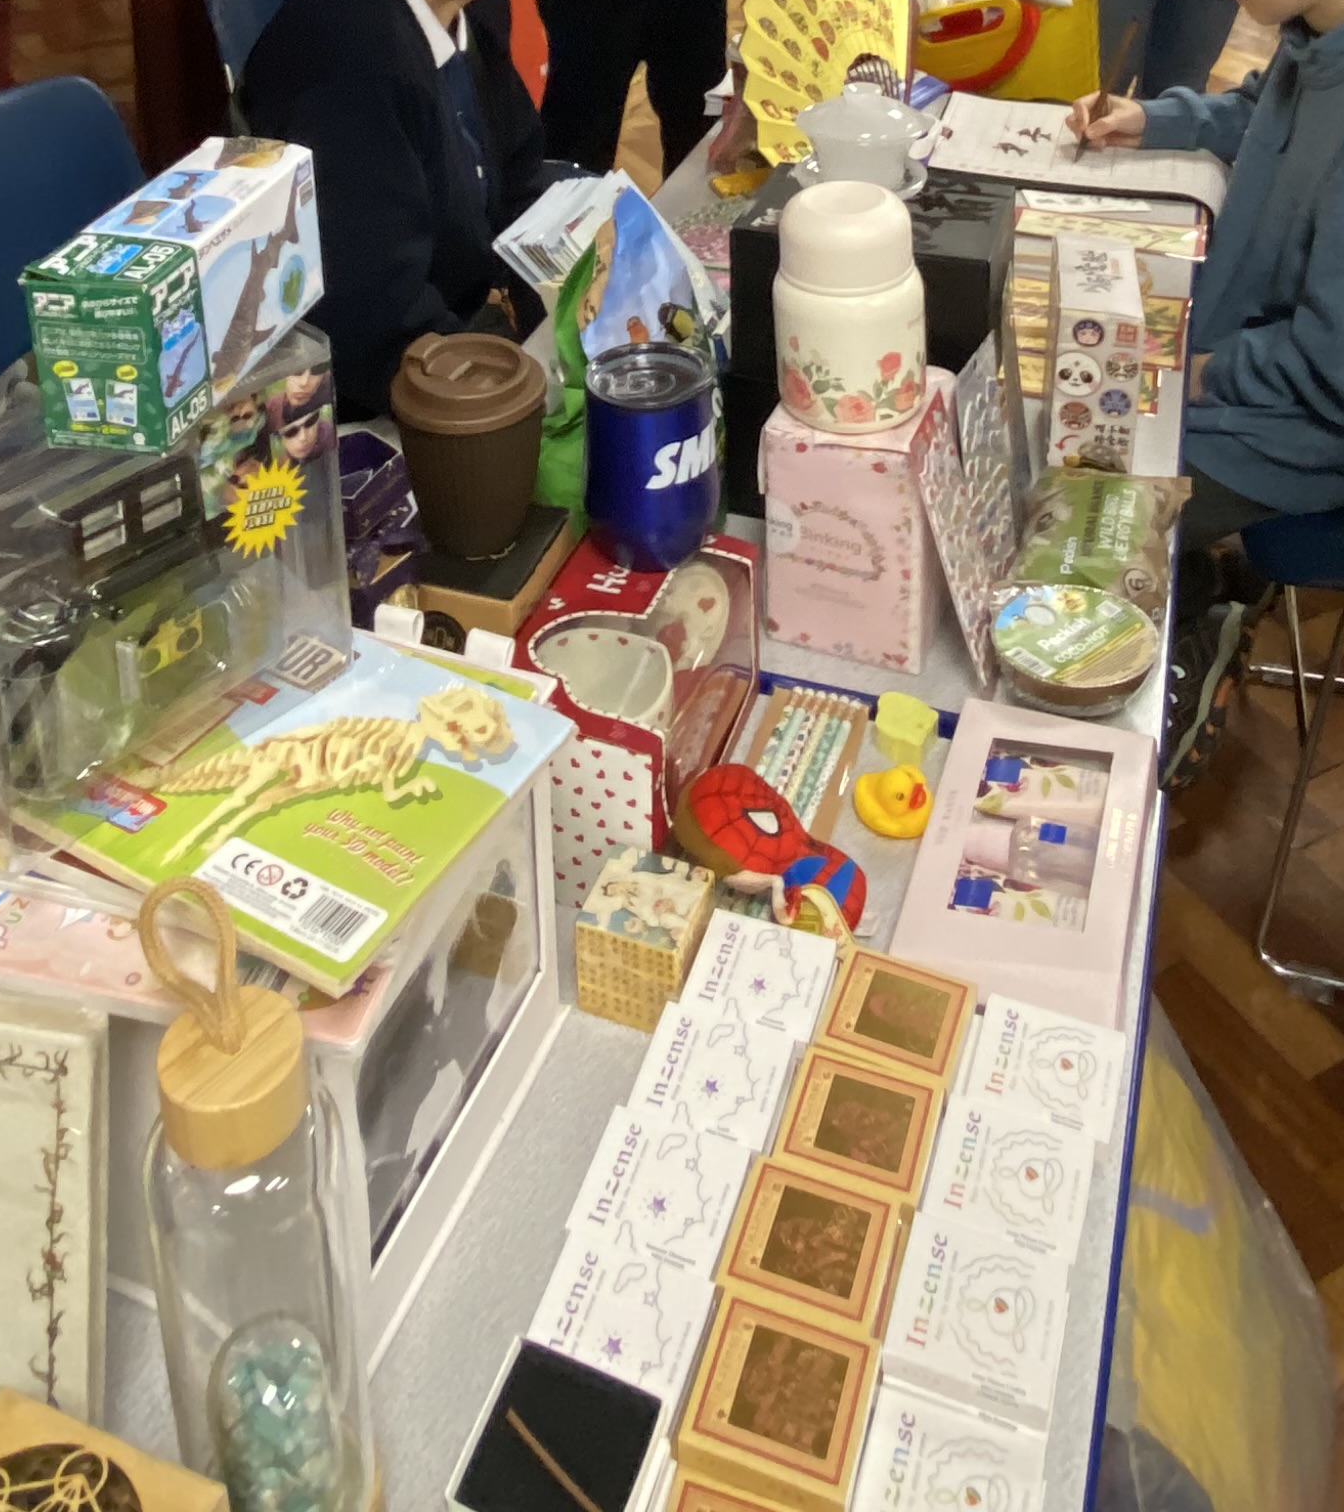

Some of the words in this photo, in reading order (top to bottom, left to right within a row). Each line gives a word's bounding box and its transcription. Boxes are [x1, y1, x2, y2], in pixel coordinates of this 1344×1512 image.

[123, 245, 175, 280] AL-05
[171, 393, 207, 441] AL-05
[1037, 617, 1091, 652] Peckish
[302, 821, 341, 847] your
[340, 833, 370, 857] 3D
[358, 852, 416, 887] model?
[327, 807, 361, 836] Why
[360, 824, 387, 849] not
[381, 834, 426, 866] paint
[698, 919, 740, 1003] Inzense
[645, 1014, 694, 1109] Inzense
[983, 1006, 1020, 1097] Inzense
[587, 1120, 644, 1228] Inzense
[942, 1108, 982, 1211] Inzense
[548, 1249, 600, 1355] nzense
[905, 1231, 949, 1350] Inzense
[883, 1410, 916, 1510] zense
